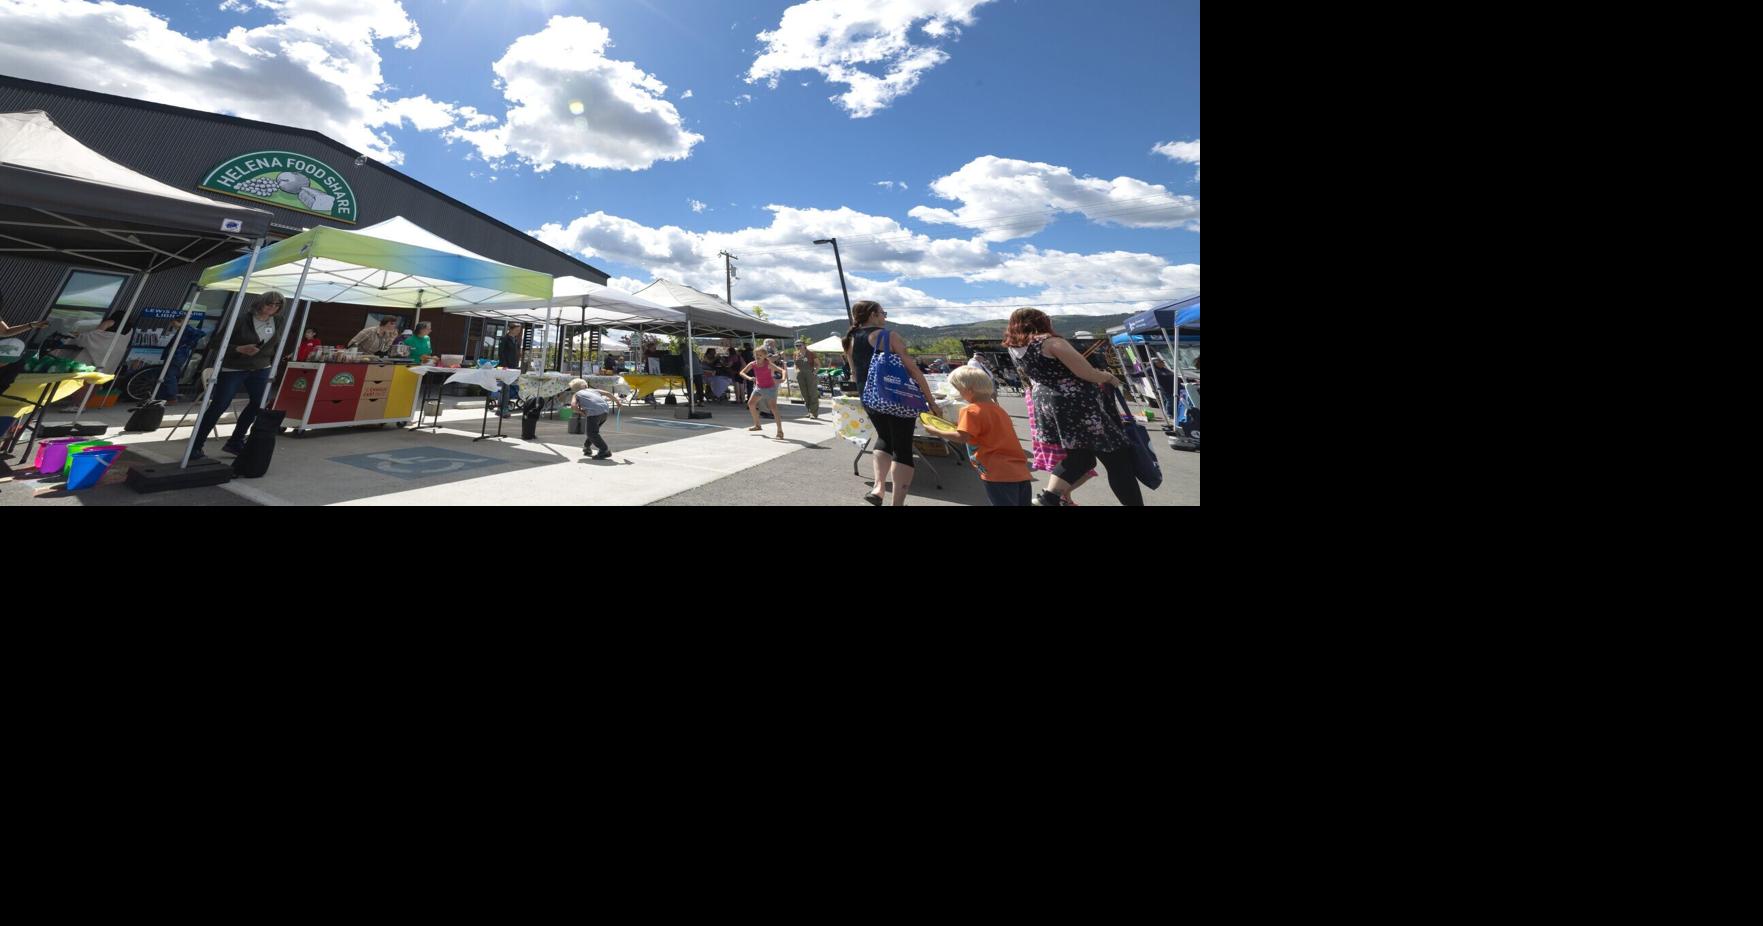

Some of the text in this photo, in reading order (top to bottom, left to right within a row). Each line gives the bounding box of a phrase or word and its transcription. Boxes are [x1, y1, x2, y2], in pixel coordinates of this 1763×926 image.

[216, 157, 350, 214] HELENA FOOD SHARE
